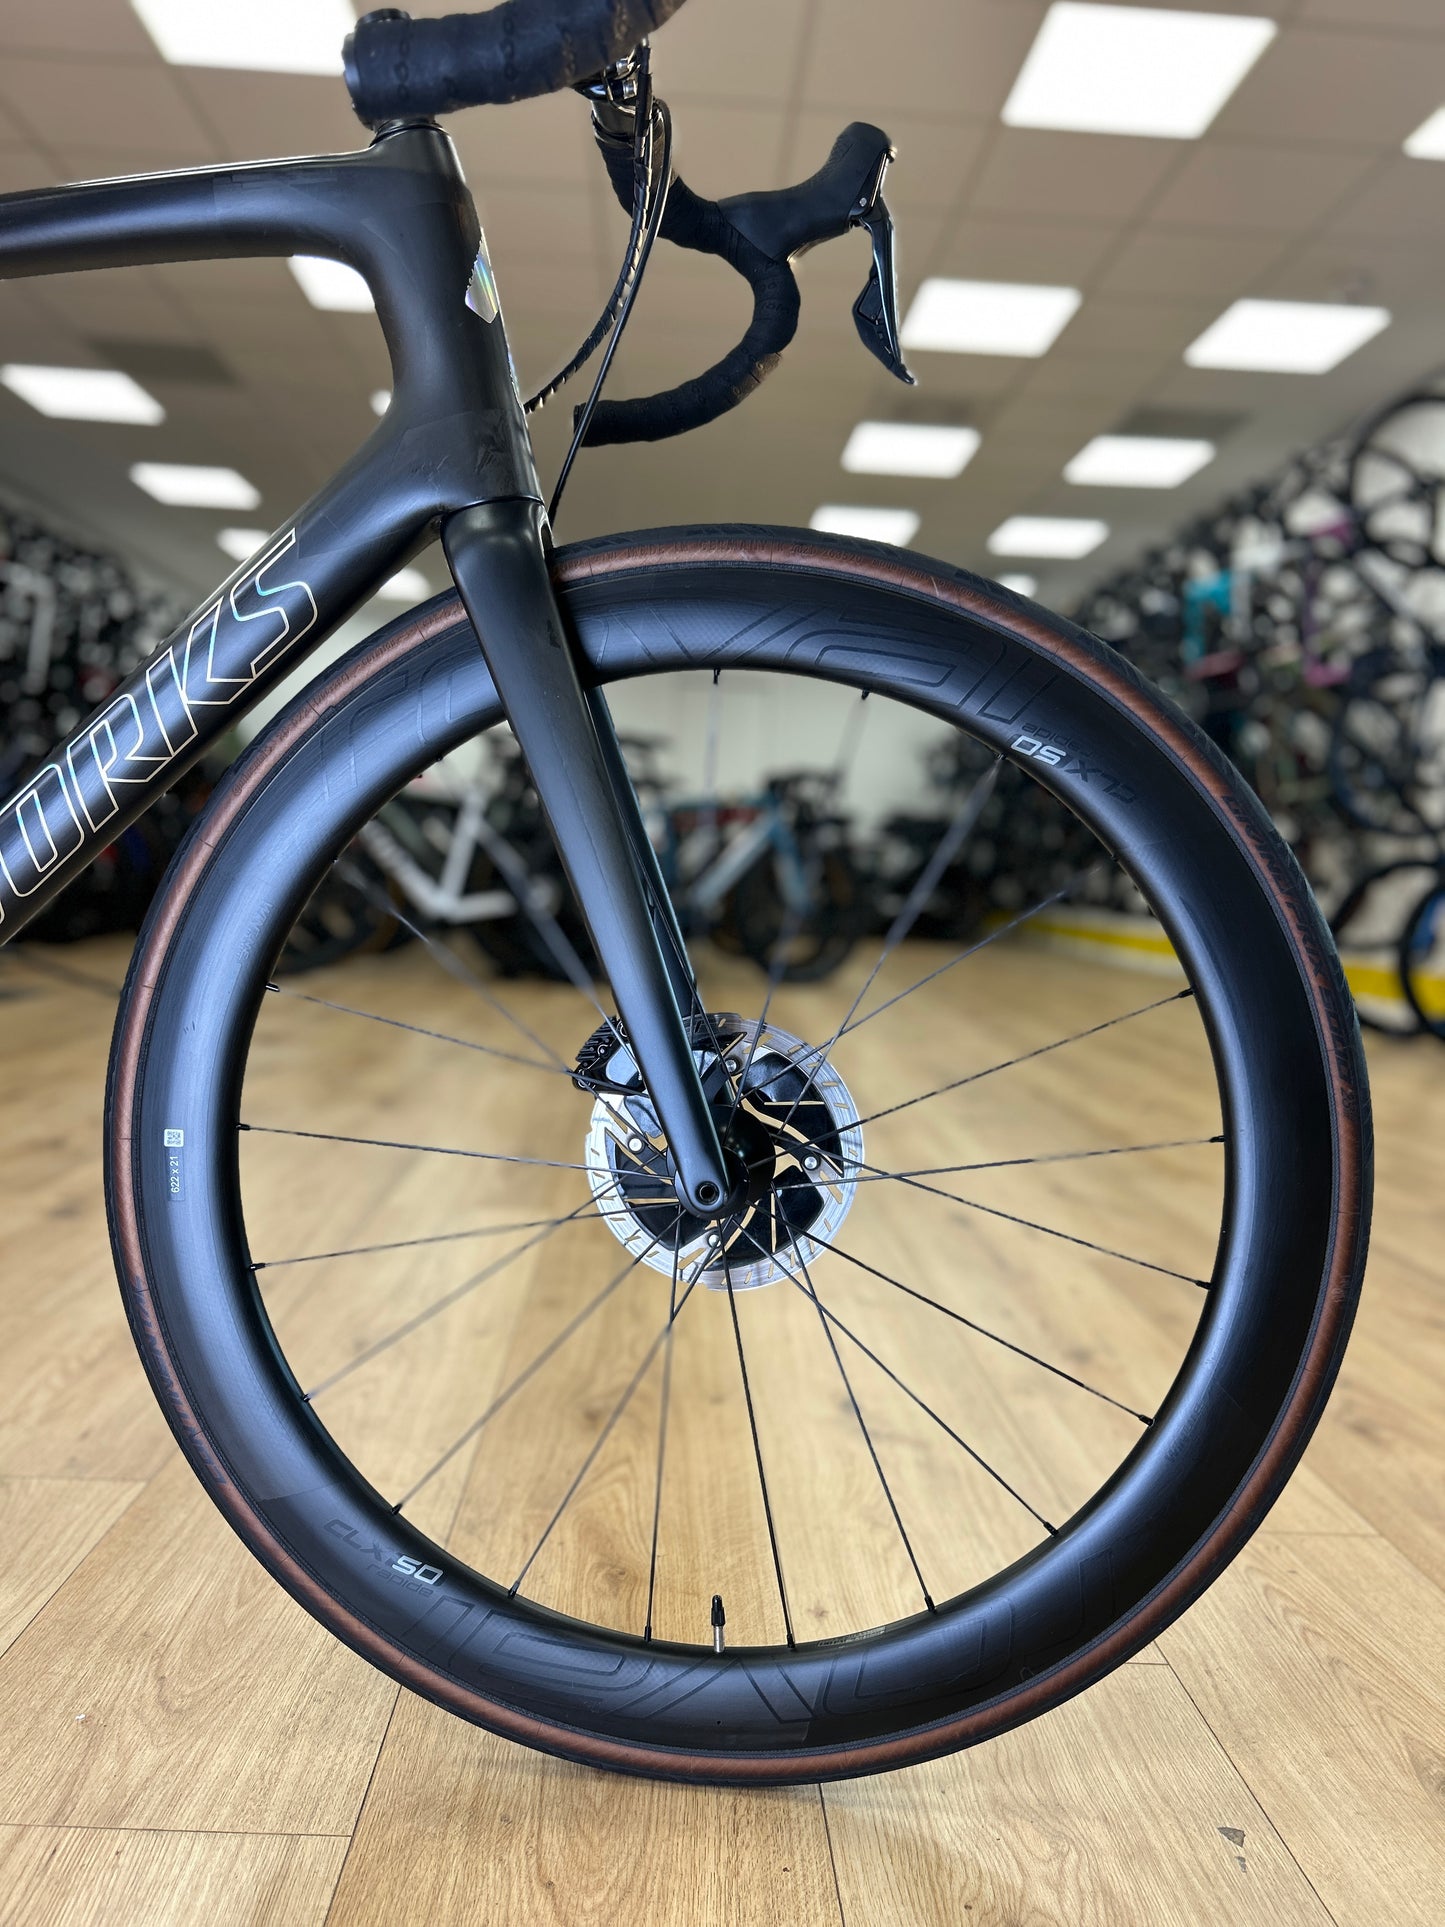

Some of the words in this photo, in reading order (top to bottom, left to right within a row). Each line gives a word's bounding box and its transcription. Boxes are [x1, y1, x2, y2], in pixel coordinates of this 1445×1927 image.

[0, 528, 318, 912] ORKS
[1010, 734, 1067, 766] 50
[170, 1156, 178, 1167] 21
[171, 1176, 180, 1193] 622
[324, 1519, 382, 1562] CLX
[390, 1554, 444, 1586] 50
[366, 1563, 434, 1598] rapide
